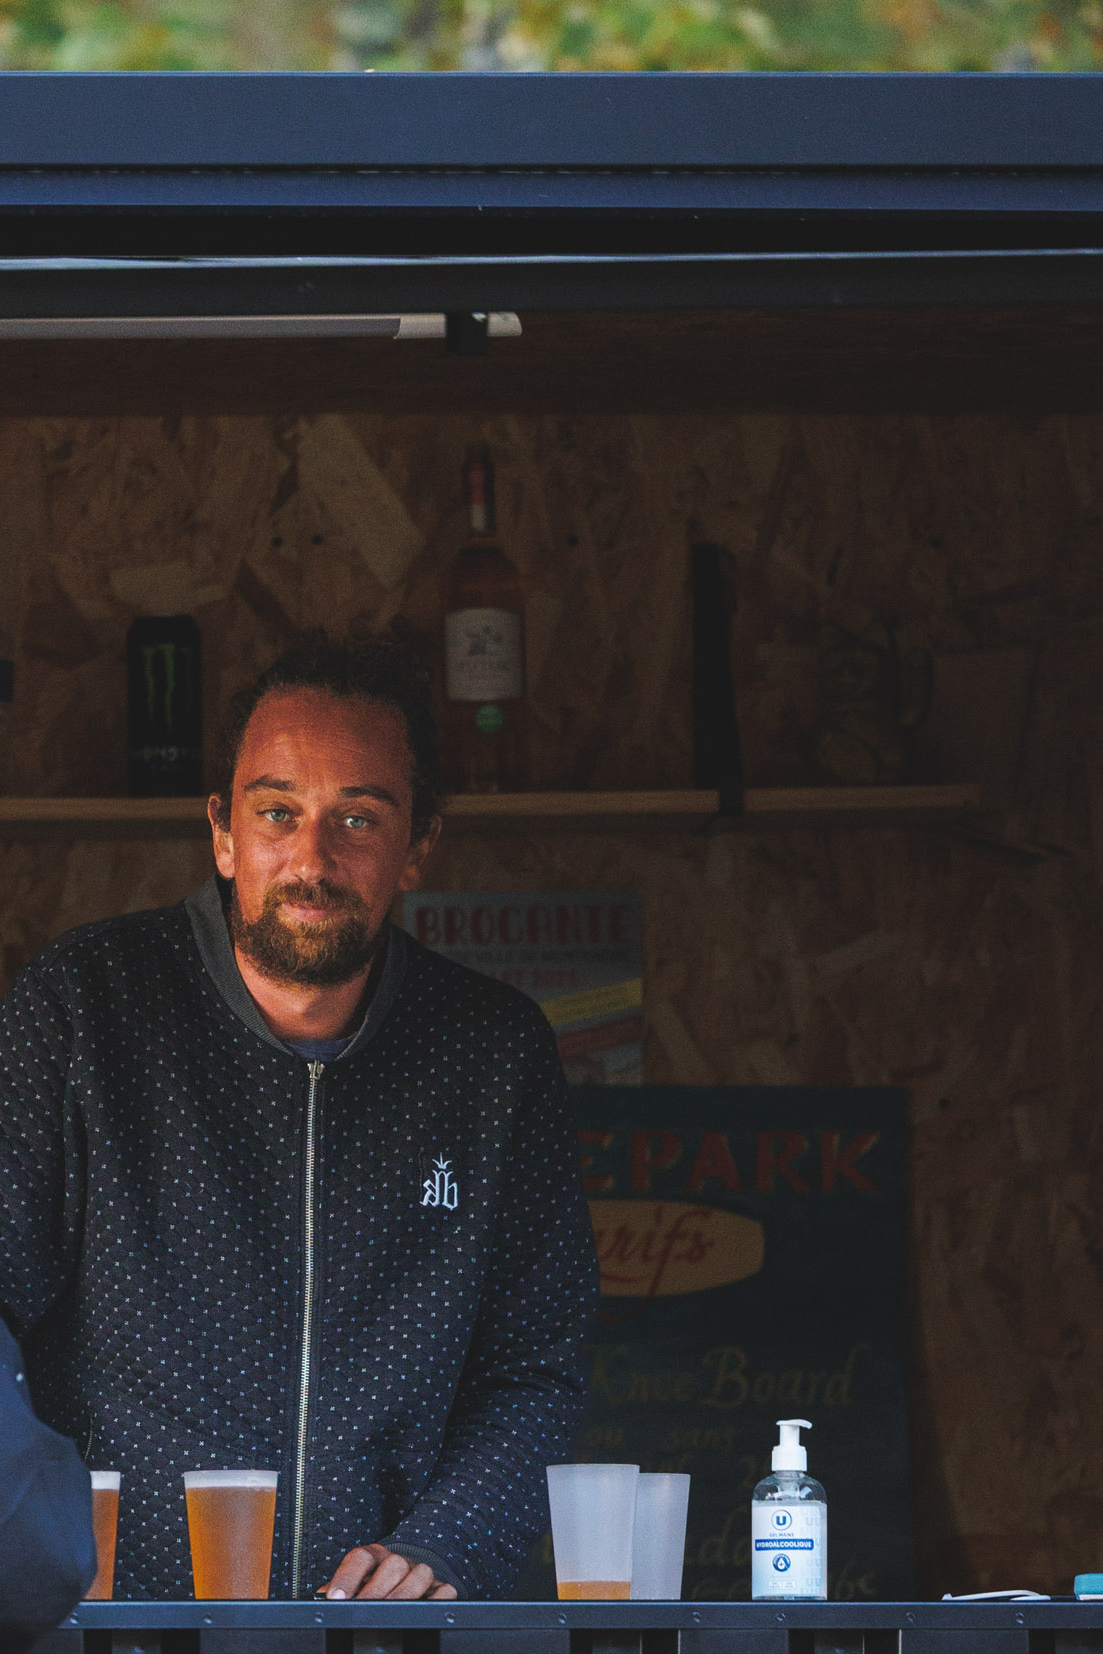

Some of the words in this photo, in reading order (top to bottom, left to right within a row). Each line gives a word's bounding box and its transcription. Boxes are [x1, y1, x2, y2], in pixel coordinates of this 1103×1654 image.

[416, 904, 632, 946] BROCANTE
[578, 1130, 880, 1192] EPARK
[699, 1343, 873, 1410] Board
[776, 1515, 787, 1526] U
[756, 1541, 812, 1549] HYDROALCOOLIQUE
